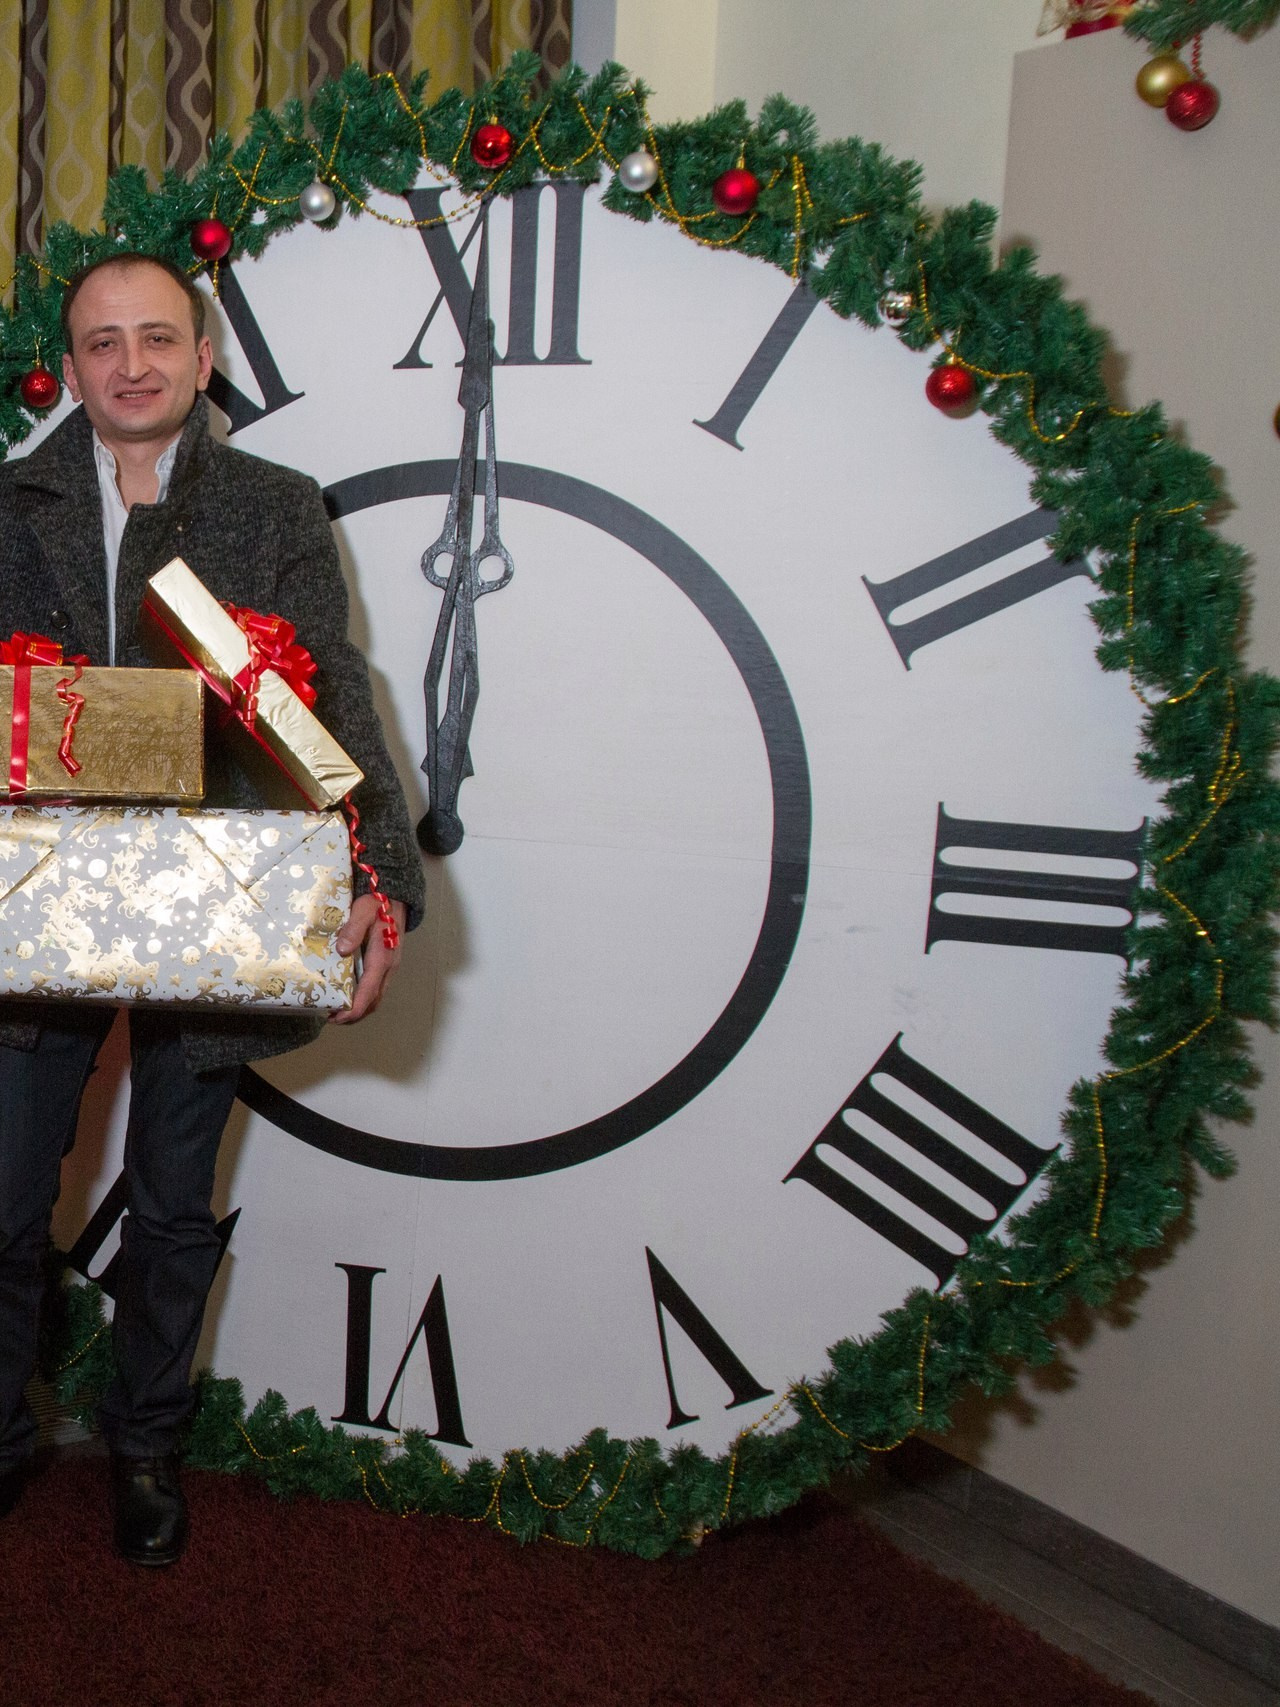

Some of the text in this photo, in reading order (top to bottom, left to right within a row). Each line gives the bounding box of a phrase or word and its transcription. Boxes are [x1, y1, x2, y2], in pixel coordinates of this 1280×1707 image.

[393, 179, 600, 369] XII
[861, 504, 1100, 671] II
[925, 802, 1150, 974] III
[781, 1031, 1063, 1293] IIII
[331, 1262, 474, 1448] VI
[646, 1246, 775, 1430] V
